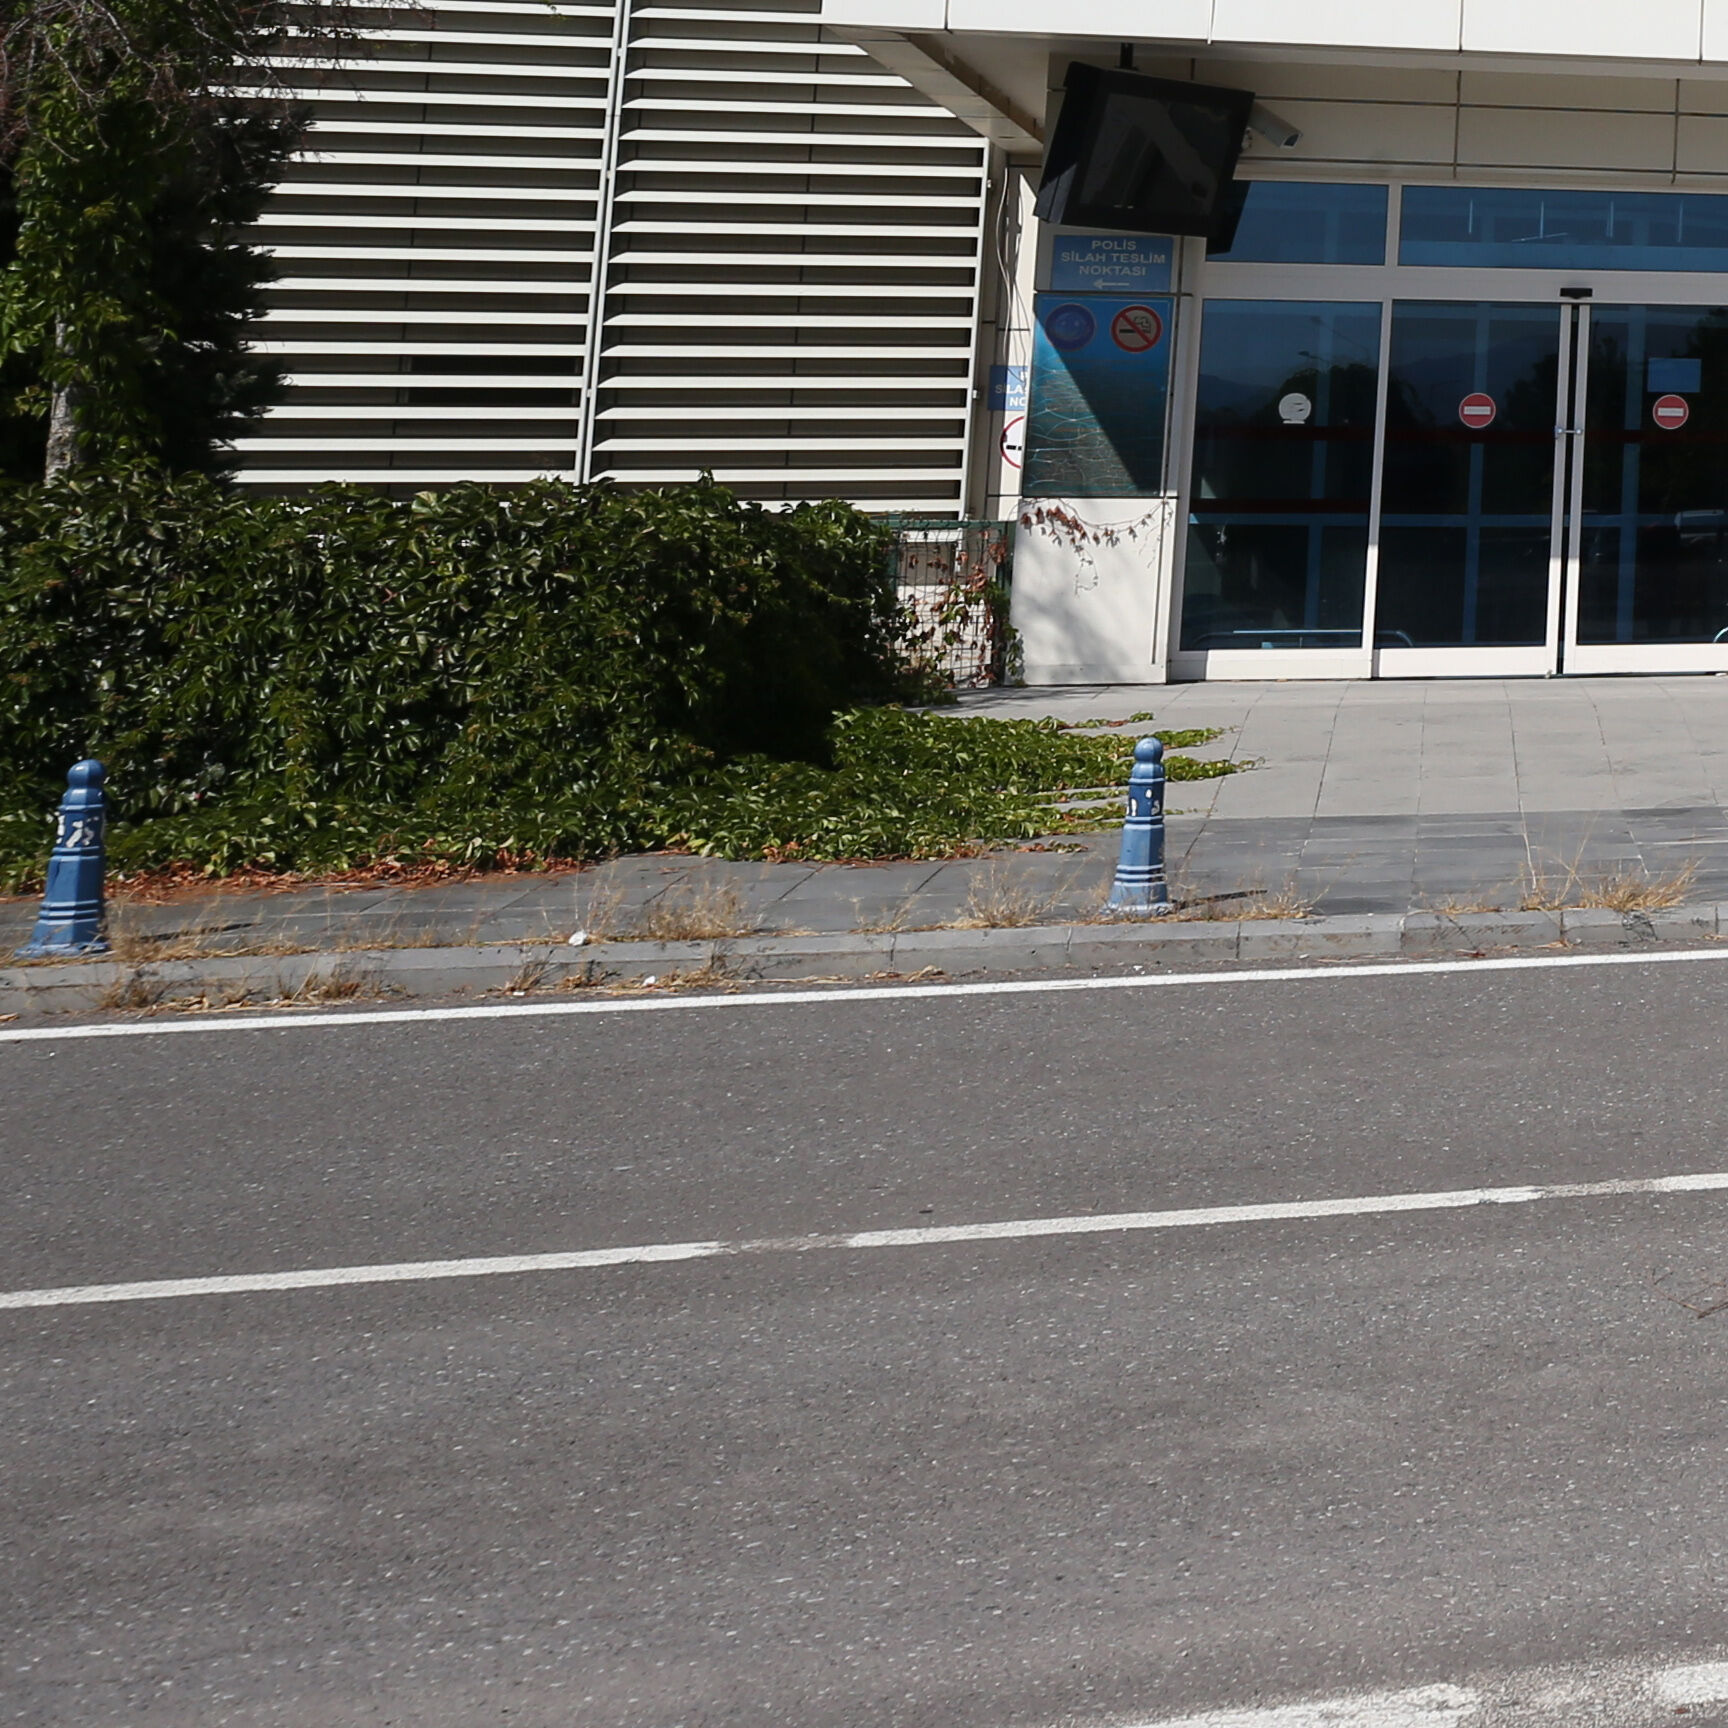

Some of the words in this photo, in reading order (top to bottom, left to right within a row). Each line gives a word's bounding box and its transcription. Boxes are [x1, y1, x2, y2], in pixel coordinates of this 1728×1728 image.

[1091, 239, 1137, 251] POLİS
[1061, 251, 1106, 263] SİLAH
[1110, 252, 1165, 264] TESLİM
[1079, 265, 1147, 277] NOKTASI
